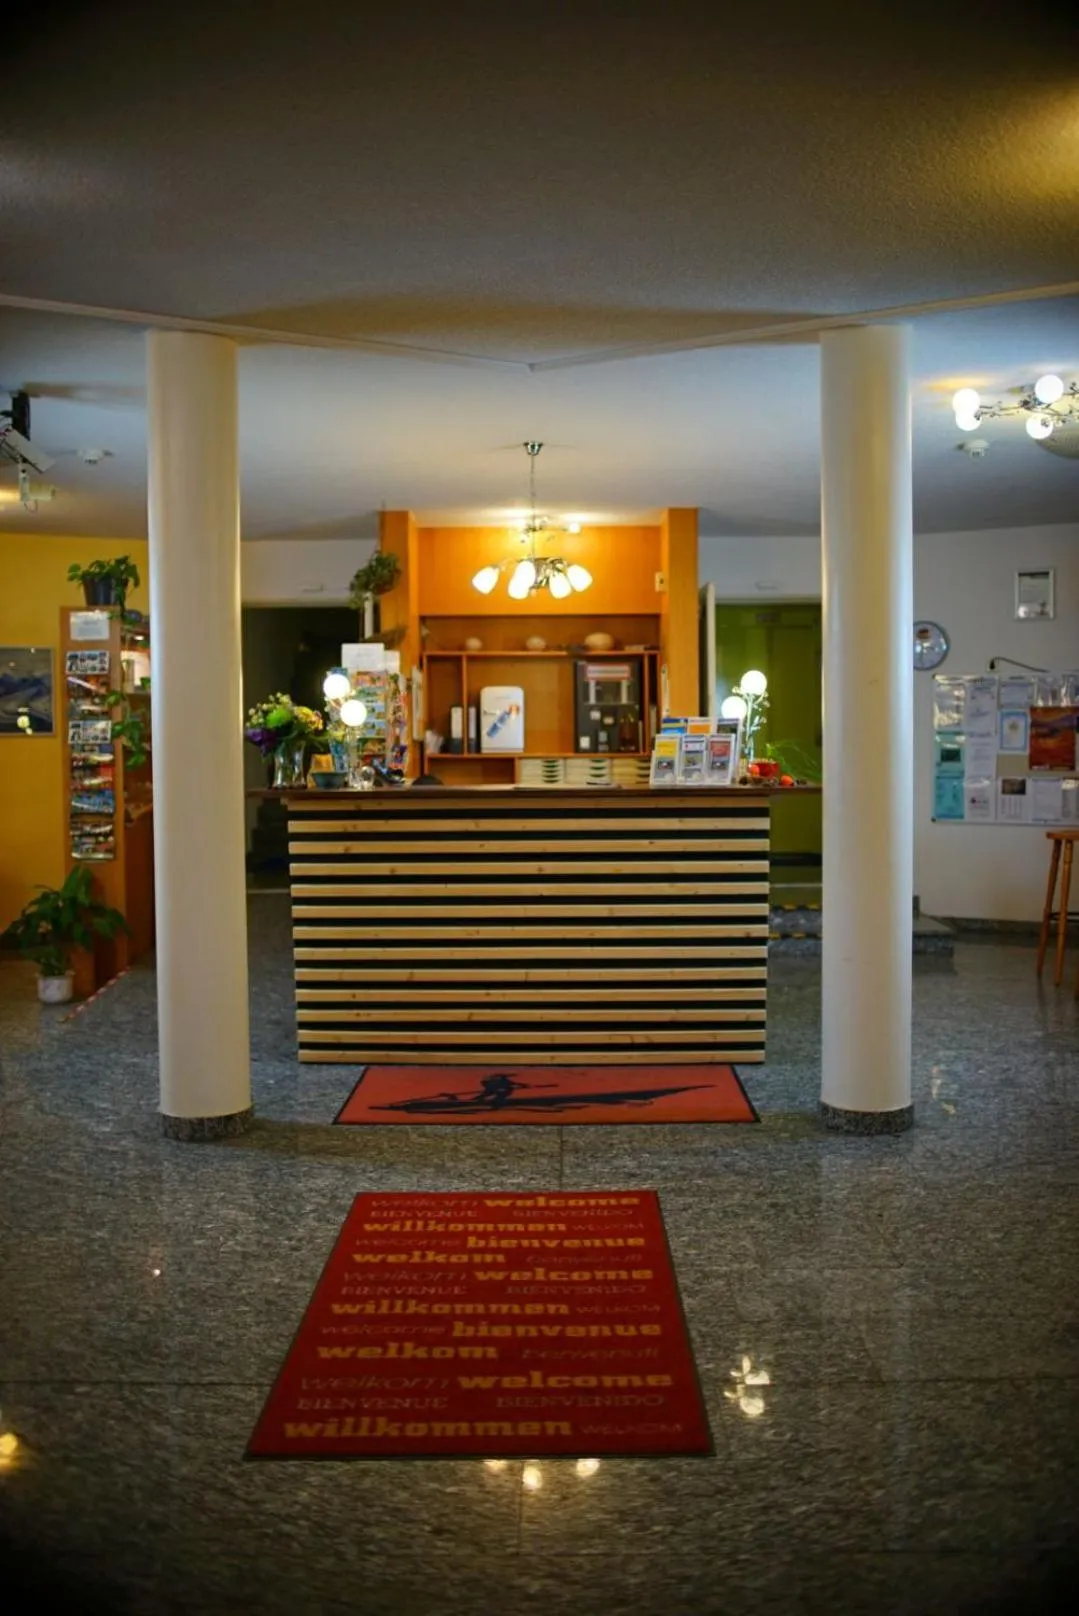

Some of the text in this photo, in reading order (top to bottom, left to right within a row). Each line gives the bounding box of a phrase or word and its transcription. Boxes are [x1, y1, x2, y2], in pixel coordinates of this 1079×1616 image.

[484, 1196, 641, 1208] welcome
[363, 1219, 567, 1232] willkommen
[466, 1235, 646, 1249] bienvenue
[352, 1250, 506, 1264] welkom
[474, 1267, 654, 1281] welcome
[331, 1298, 570, 1315] willkommen
[452, 1320, 662, 1337] bienvenue
[317, 1341, 499, 1359] welkom
[456, 1370, 674, 1389] welcome
[296, 1397, 449, 1411] BIENVENUE
[283, 1416, 573, 1439] willkommen
